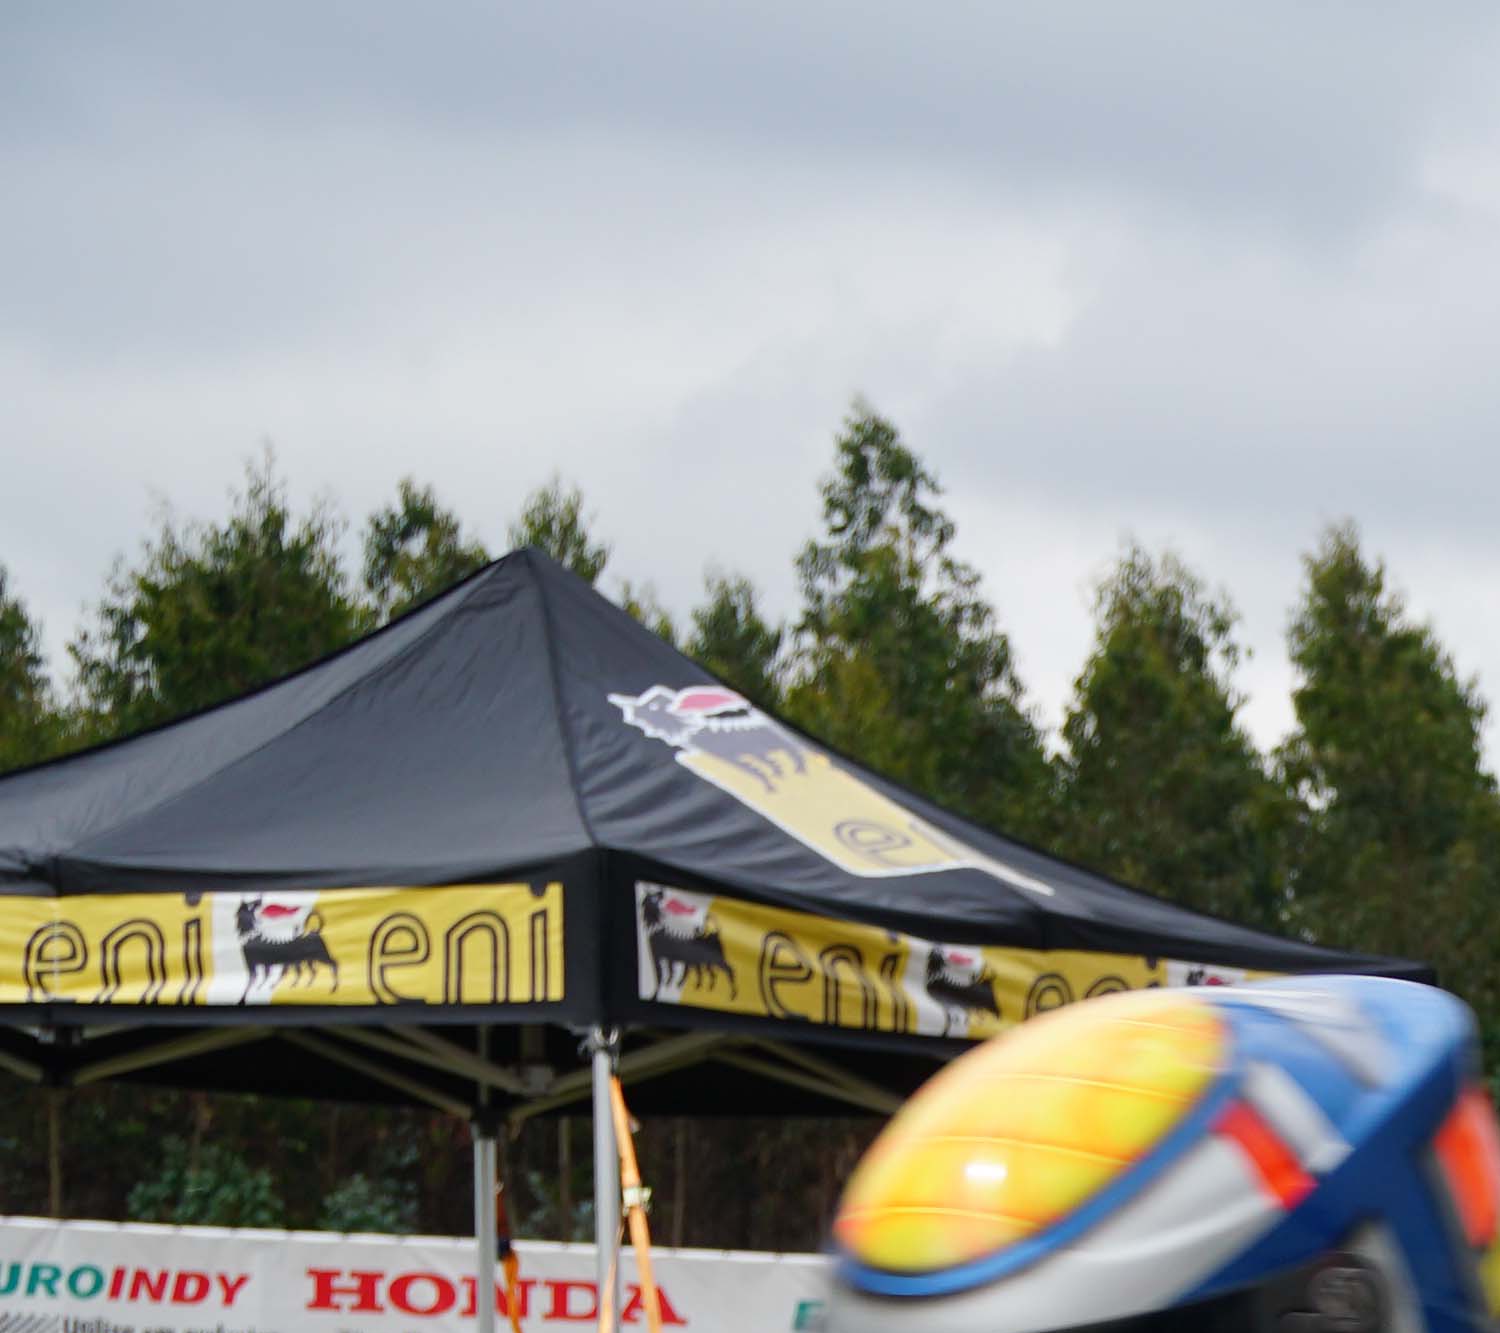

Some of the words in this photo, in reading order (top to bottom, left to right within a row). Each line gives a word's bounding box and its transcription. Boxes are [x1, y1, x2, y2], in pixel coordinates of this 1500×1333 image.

[24, 892, 201, 1004] eni
[368, 884, 549, 1004] eni
[760, 930, 908, 1032] eni
[0, 1264, 250, 1308] UROINDY
